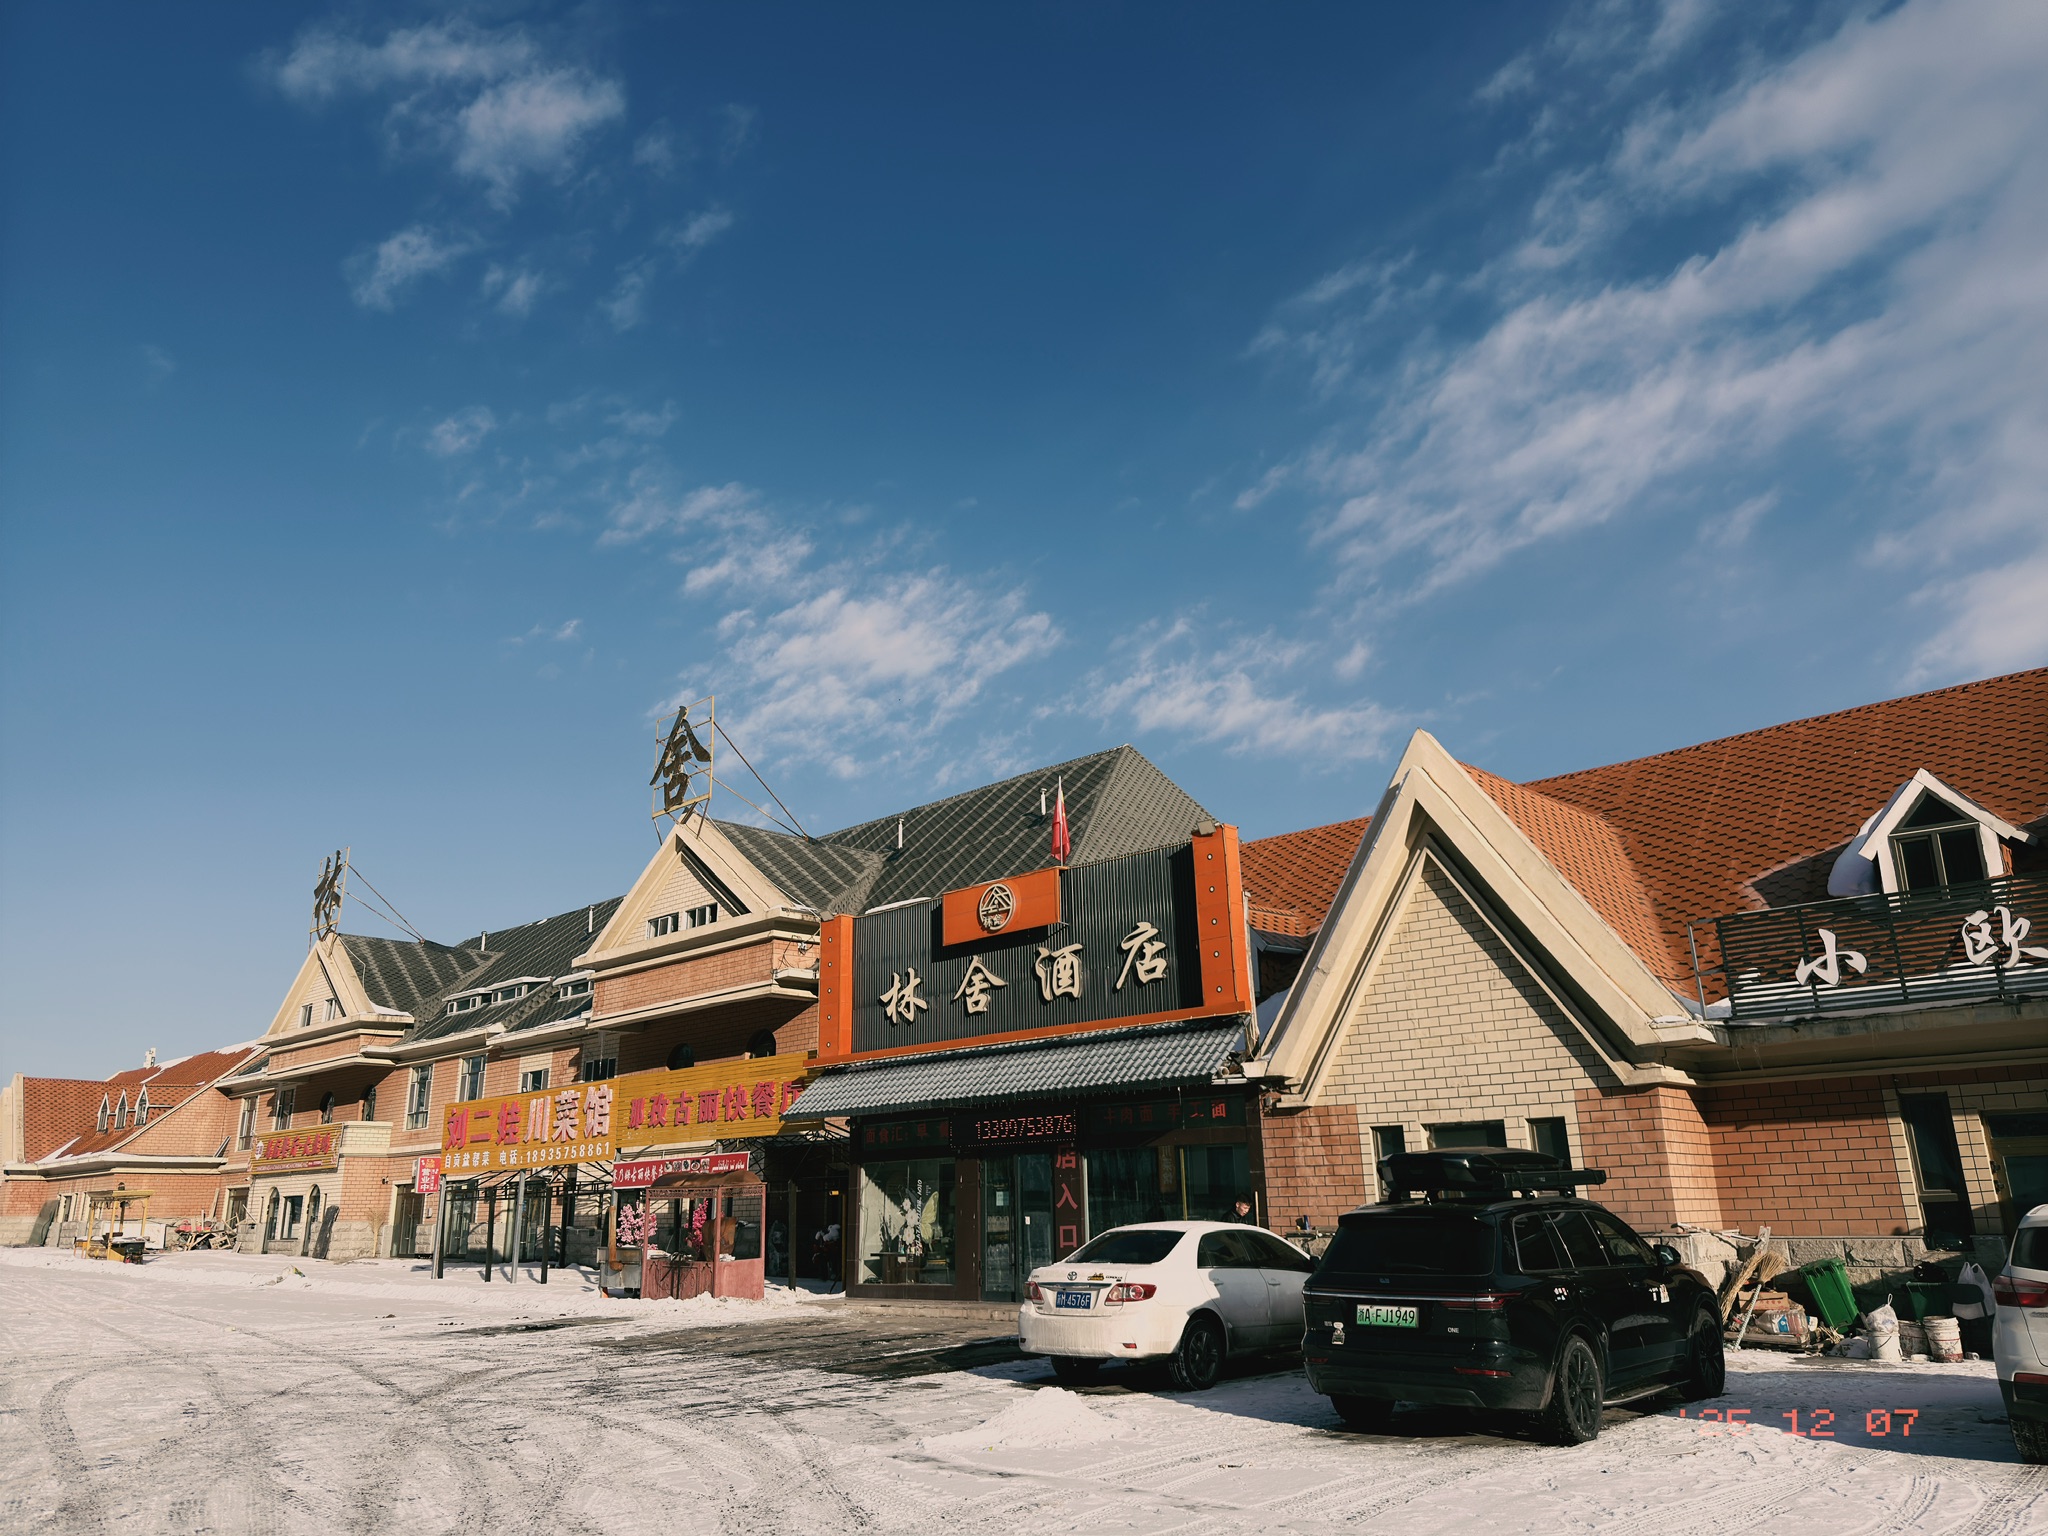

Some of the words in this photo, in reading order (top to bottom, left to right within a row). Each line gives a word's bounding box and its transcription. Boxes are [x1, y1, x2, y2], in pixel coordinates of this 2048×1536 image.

[649, 705, 711, 812] 舍
[880, 921, 1168, 1025] 林舍酒店
[1795, 905, 2048, 987] 小欧
[445, 1084, 613, 1150] 刘二娃川菜馆
[628, 1081, 804, 1129] 那孜古丽快餐厅
[976, 1114, 1073, 1139] 13399753876
[1447, 1326, 1460, 1334] ONE
